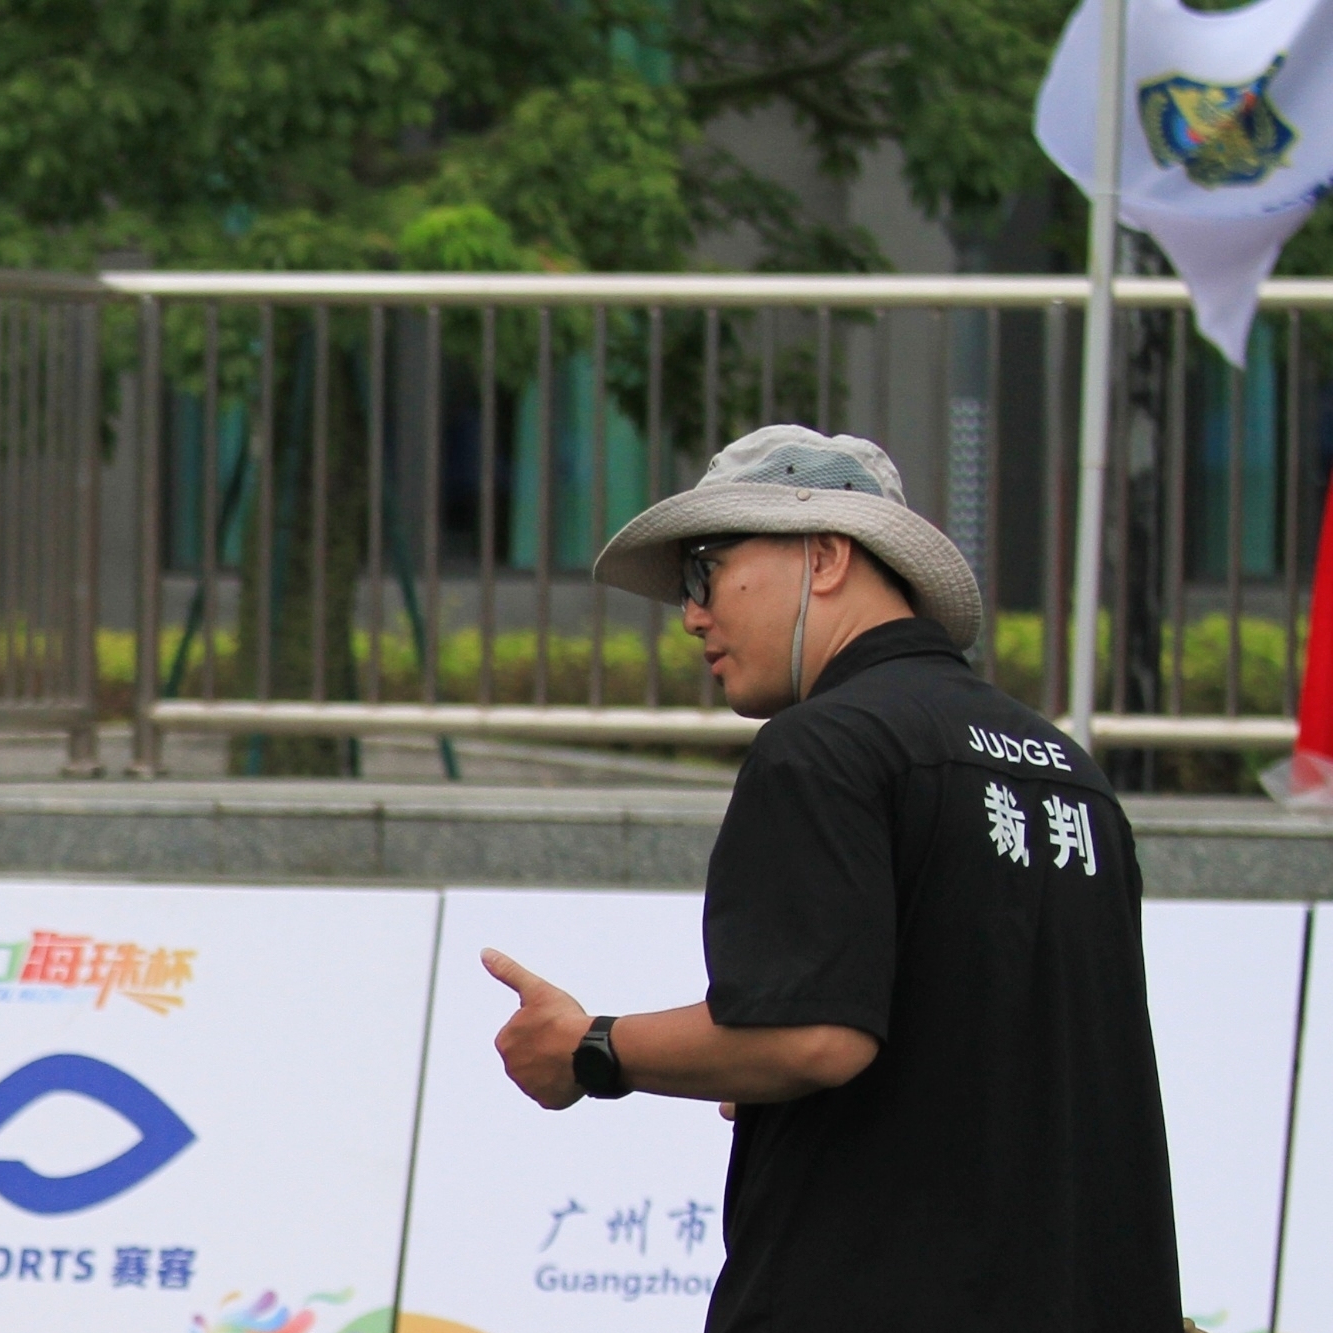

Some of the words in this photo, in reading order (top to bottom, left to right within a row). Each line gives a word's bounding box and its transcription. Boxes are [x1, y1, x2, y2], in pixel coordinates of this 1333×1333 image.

[967, 724, 1073, 773] JUDGE
[983, 780, 1098, 877] 裁判
[111, 1246, 197, 1289] 赛客
